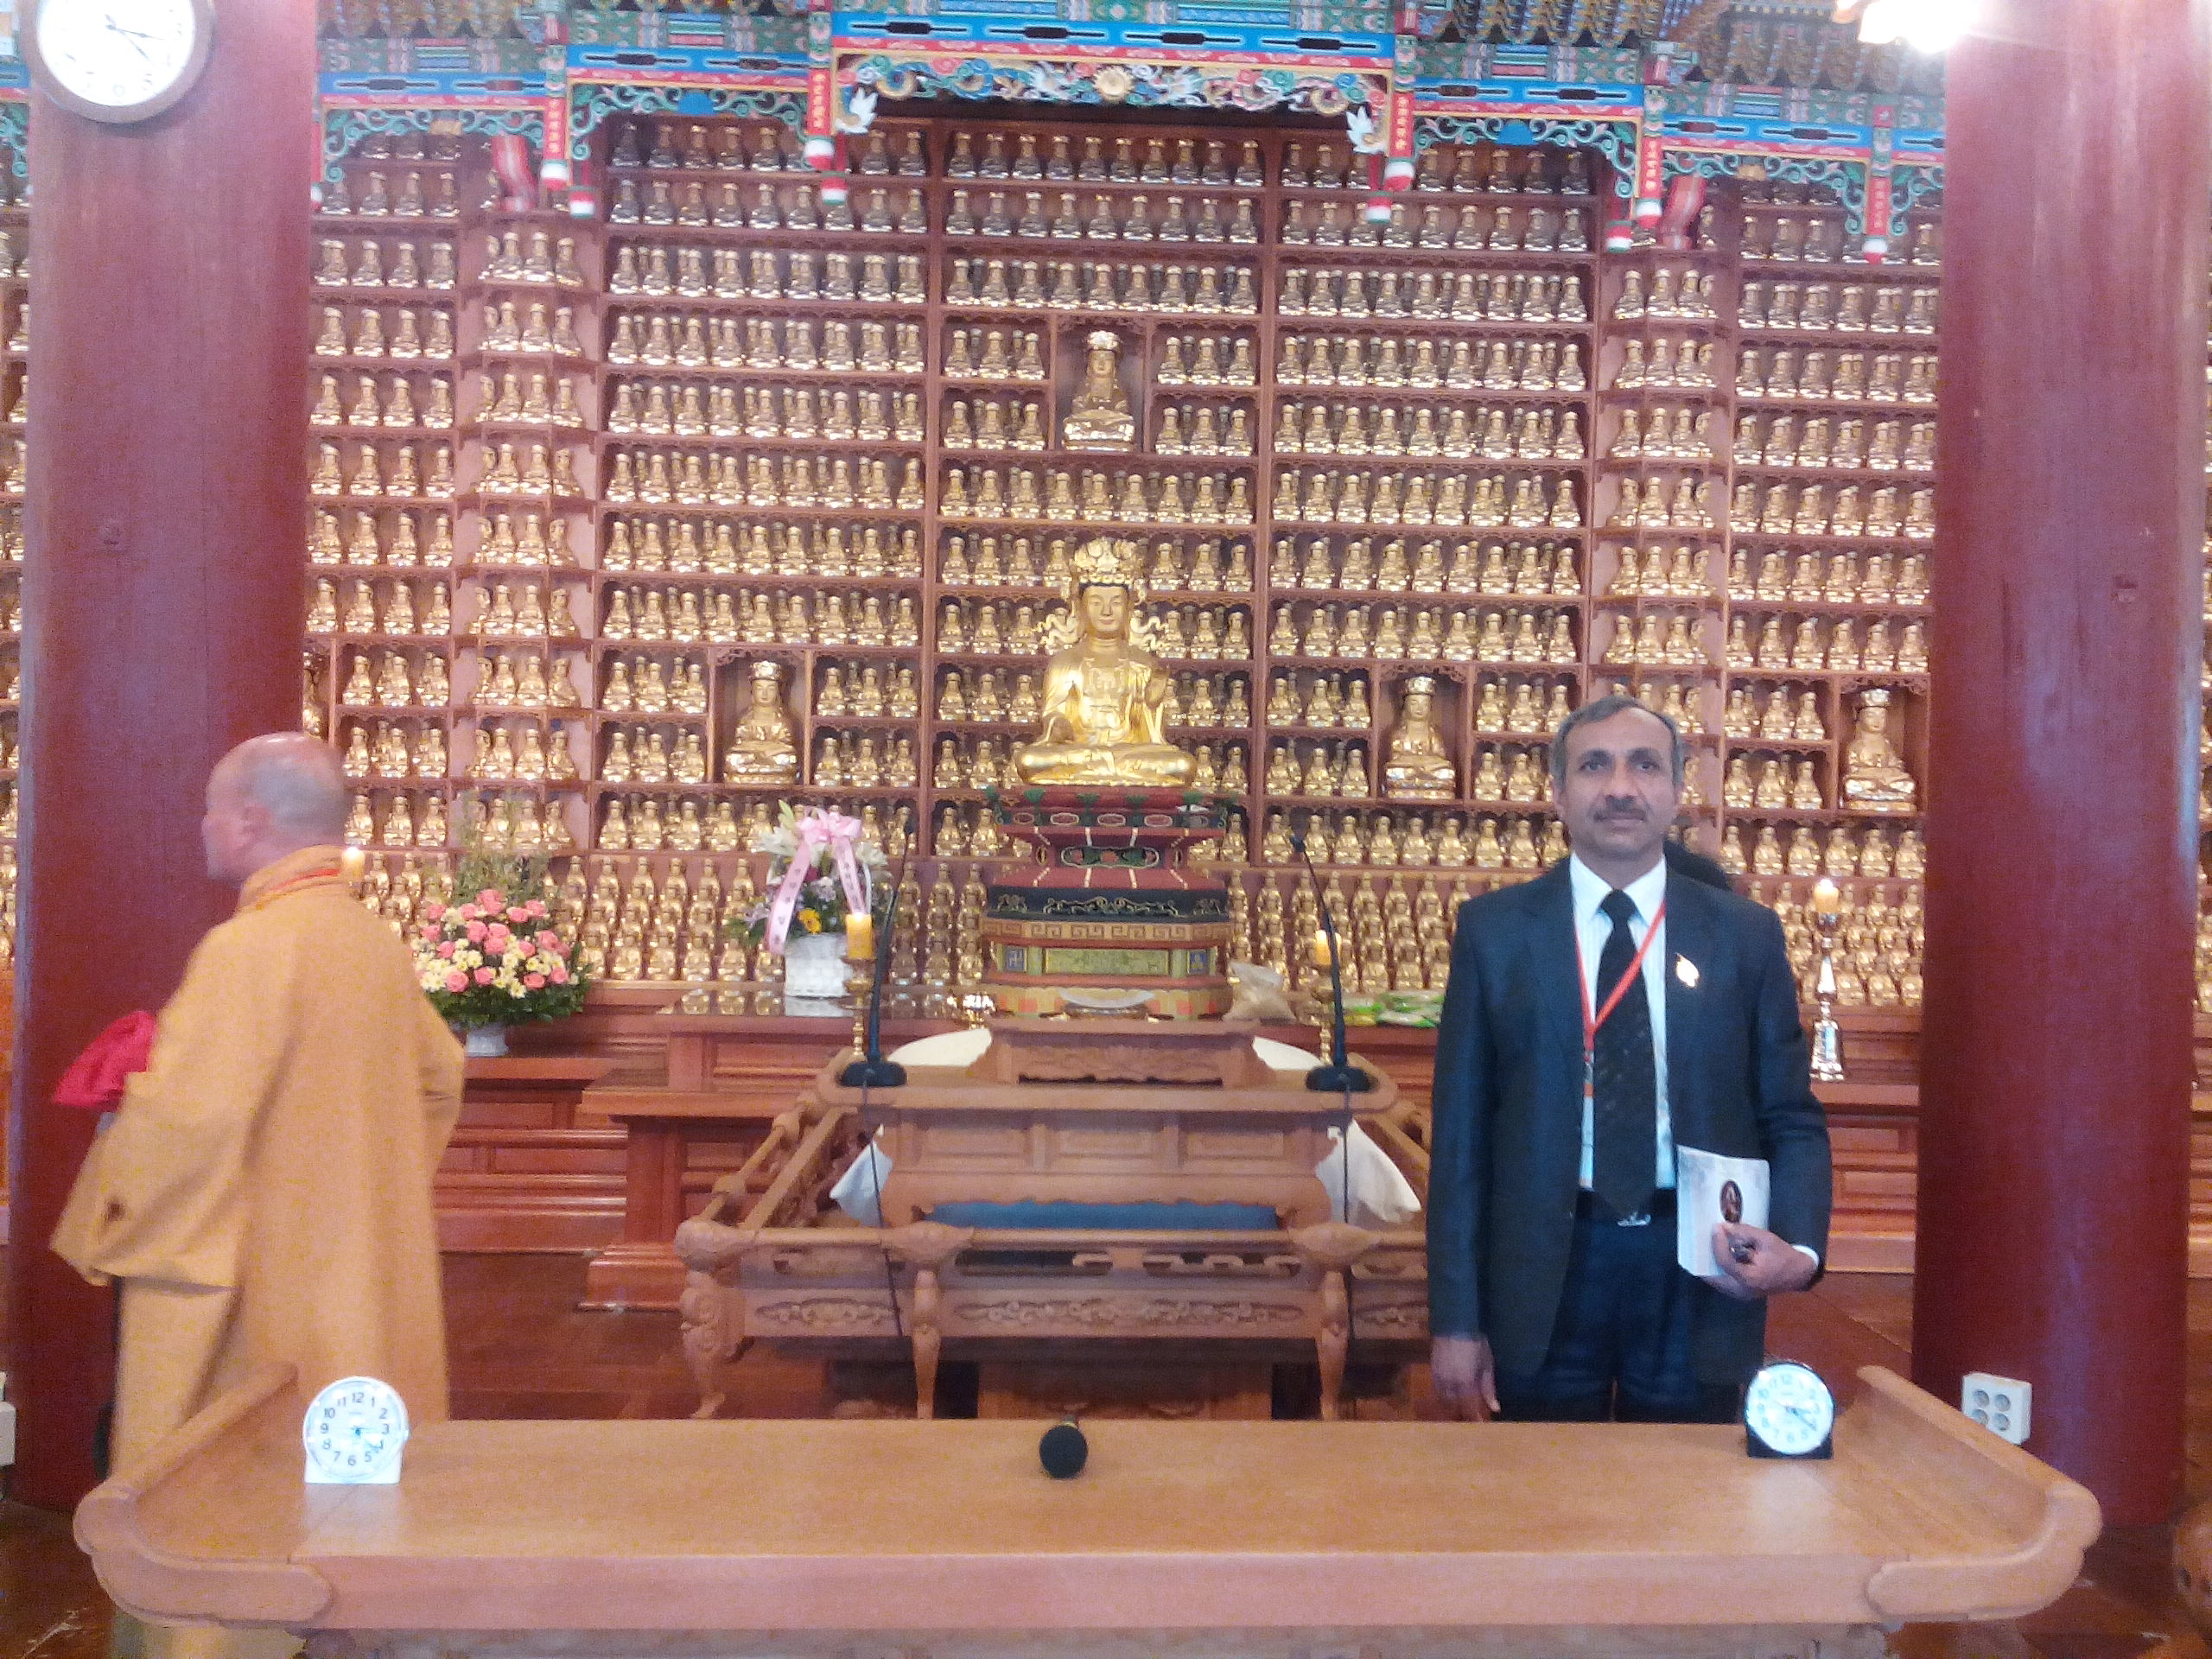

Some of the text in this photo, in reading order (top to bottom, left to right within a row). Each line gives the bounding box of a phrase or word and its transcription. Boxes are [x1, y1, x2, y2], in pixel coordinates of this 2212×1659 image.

[337, 1397, 346, 1407] 11
[352, 1392, 365, 1403] 12
[372, 1396, 375, 1407] 1
[324, 1408, 335, 1419] 10
[378, 1408, 387, 1419] 2
[321, 1423, 328, 1433] 9
[382, 1424, 389, 1434] 3
[322, 1439, 331, 1450] 8
[334, 1451, 340, 1462] 7
[347, 1455, 355, 1465] 6
[365, 1451, 372, 1462] 5
